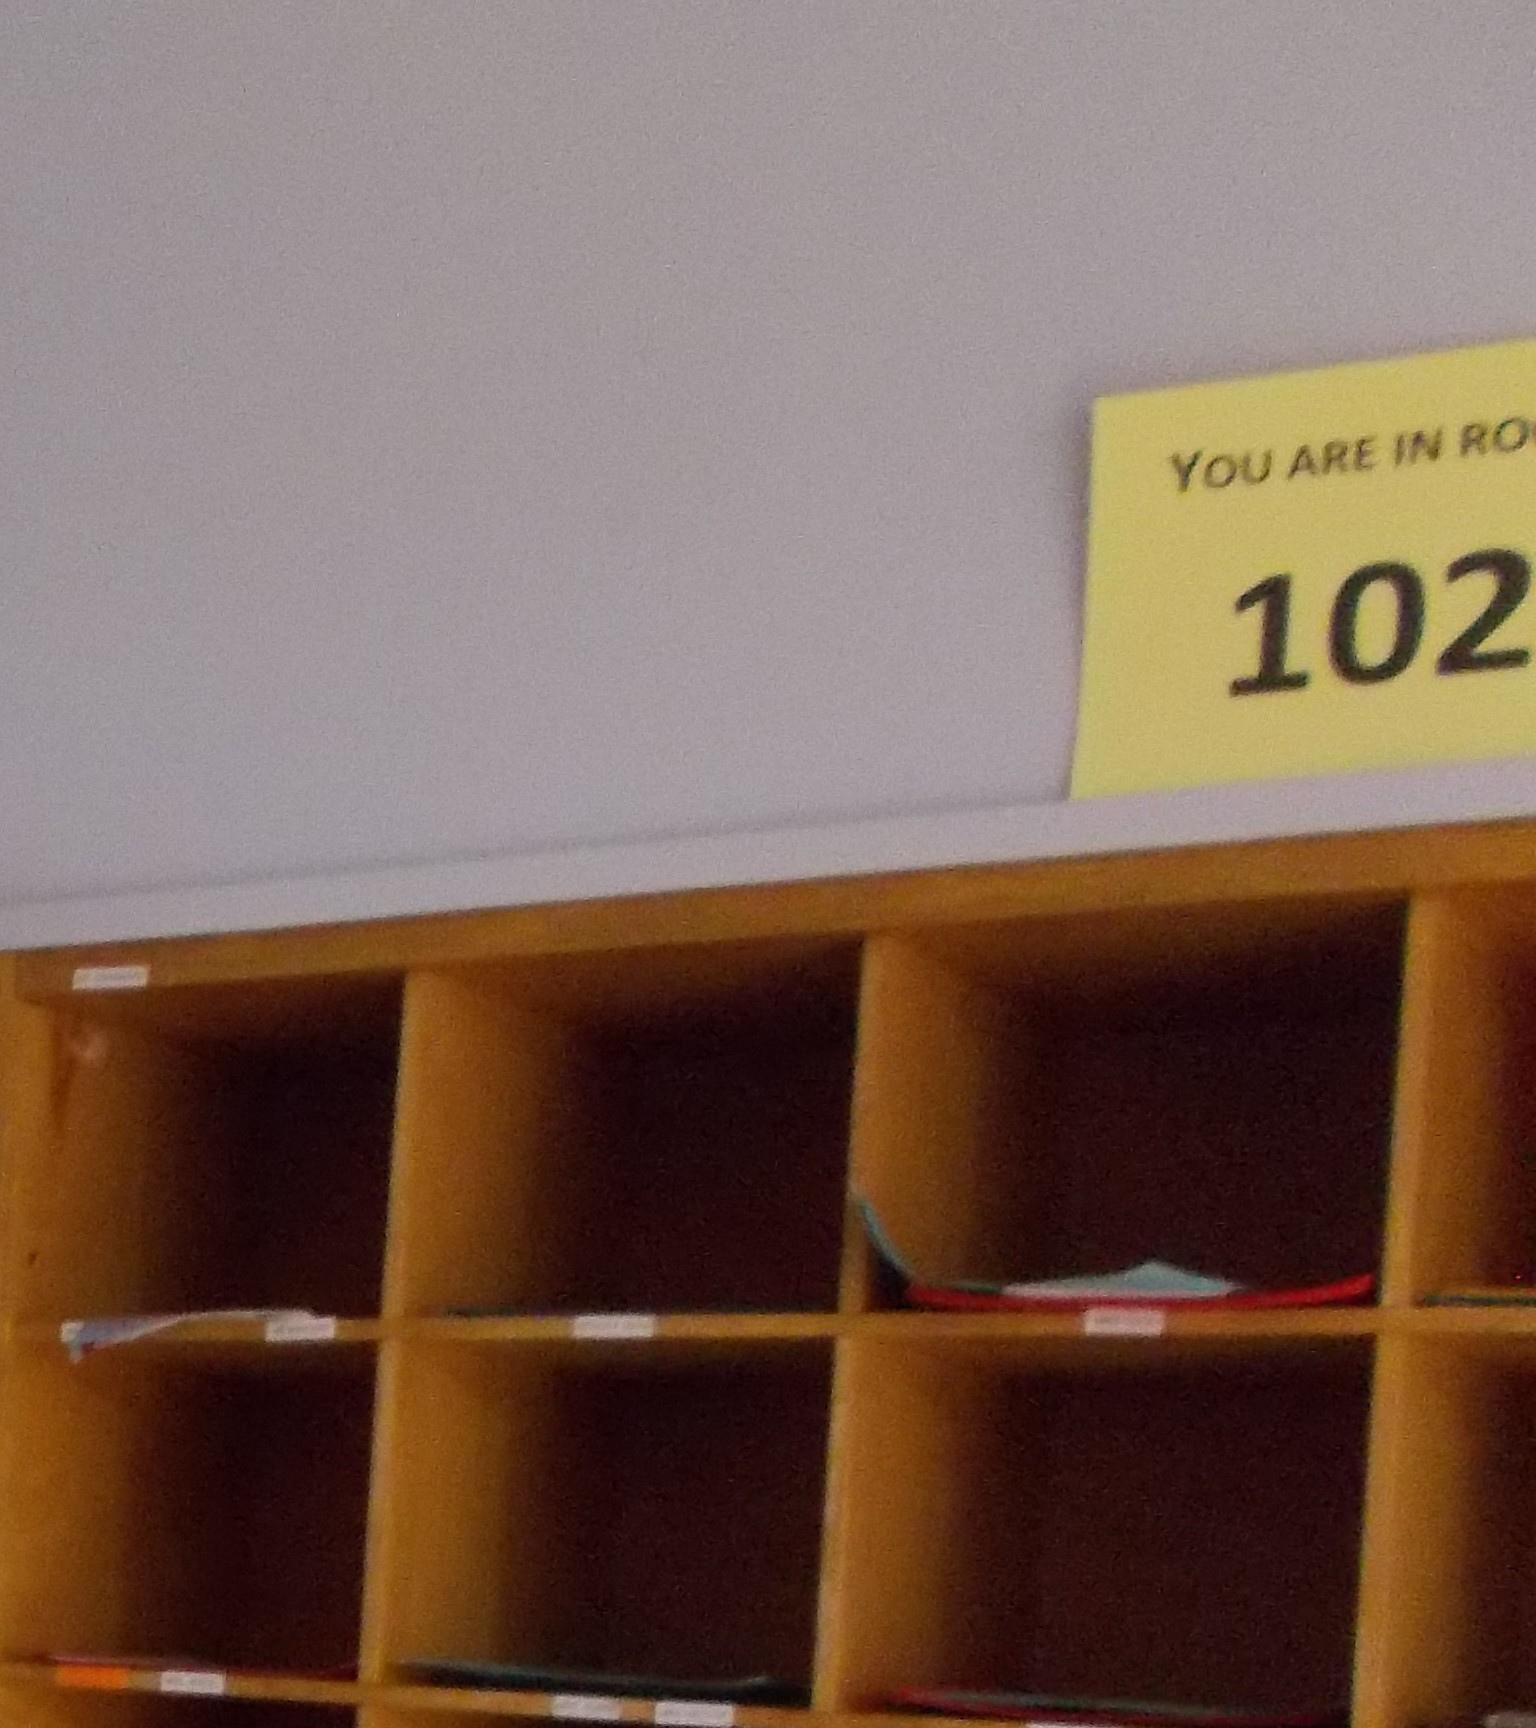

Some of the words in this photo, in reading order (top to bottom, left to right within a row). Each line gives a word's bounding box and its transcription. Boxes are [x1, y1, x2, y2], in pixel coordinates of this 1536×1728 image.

[1169, 449, 1273, 493] YOU
[1287, 434, 1378, 481] ARE
[1393, 425, 1444, 467] IN
[1458, 415, 1536, 457] RO
[1228, 546, 1534, 699] 102
